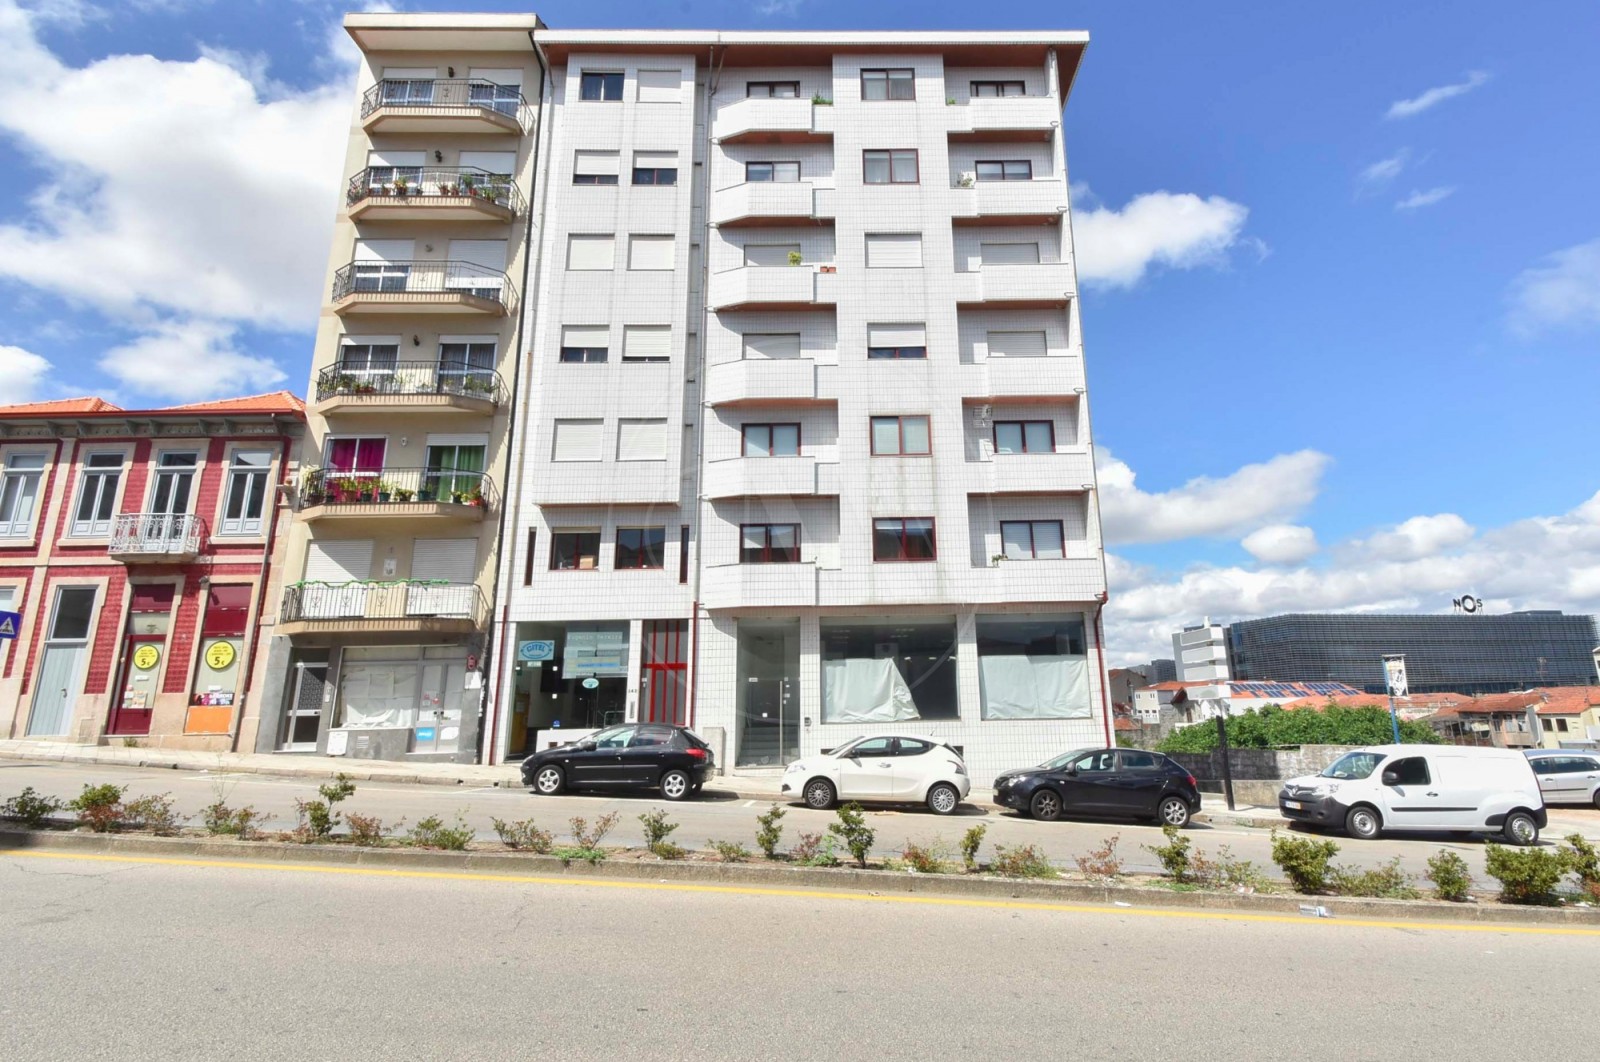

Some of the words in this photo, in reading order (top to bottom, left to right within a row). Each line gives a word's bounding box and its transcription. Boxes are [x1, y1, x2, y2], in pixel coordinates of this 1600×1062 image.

[1452, 595, 1483, 613] NOS
[141, 658, 146, 666] 5
[214, 656, 220, 665] 5
